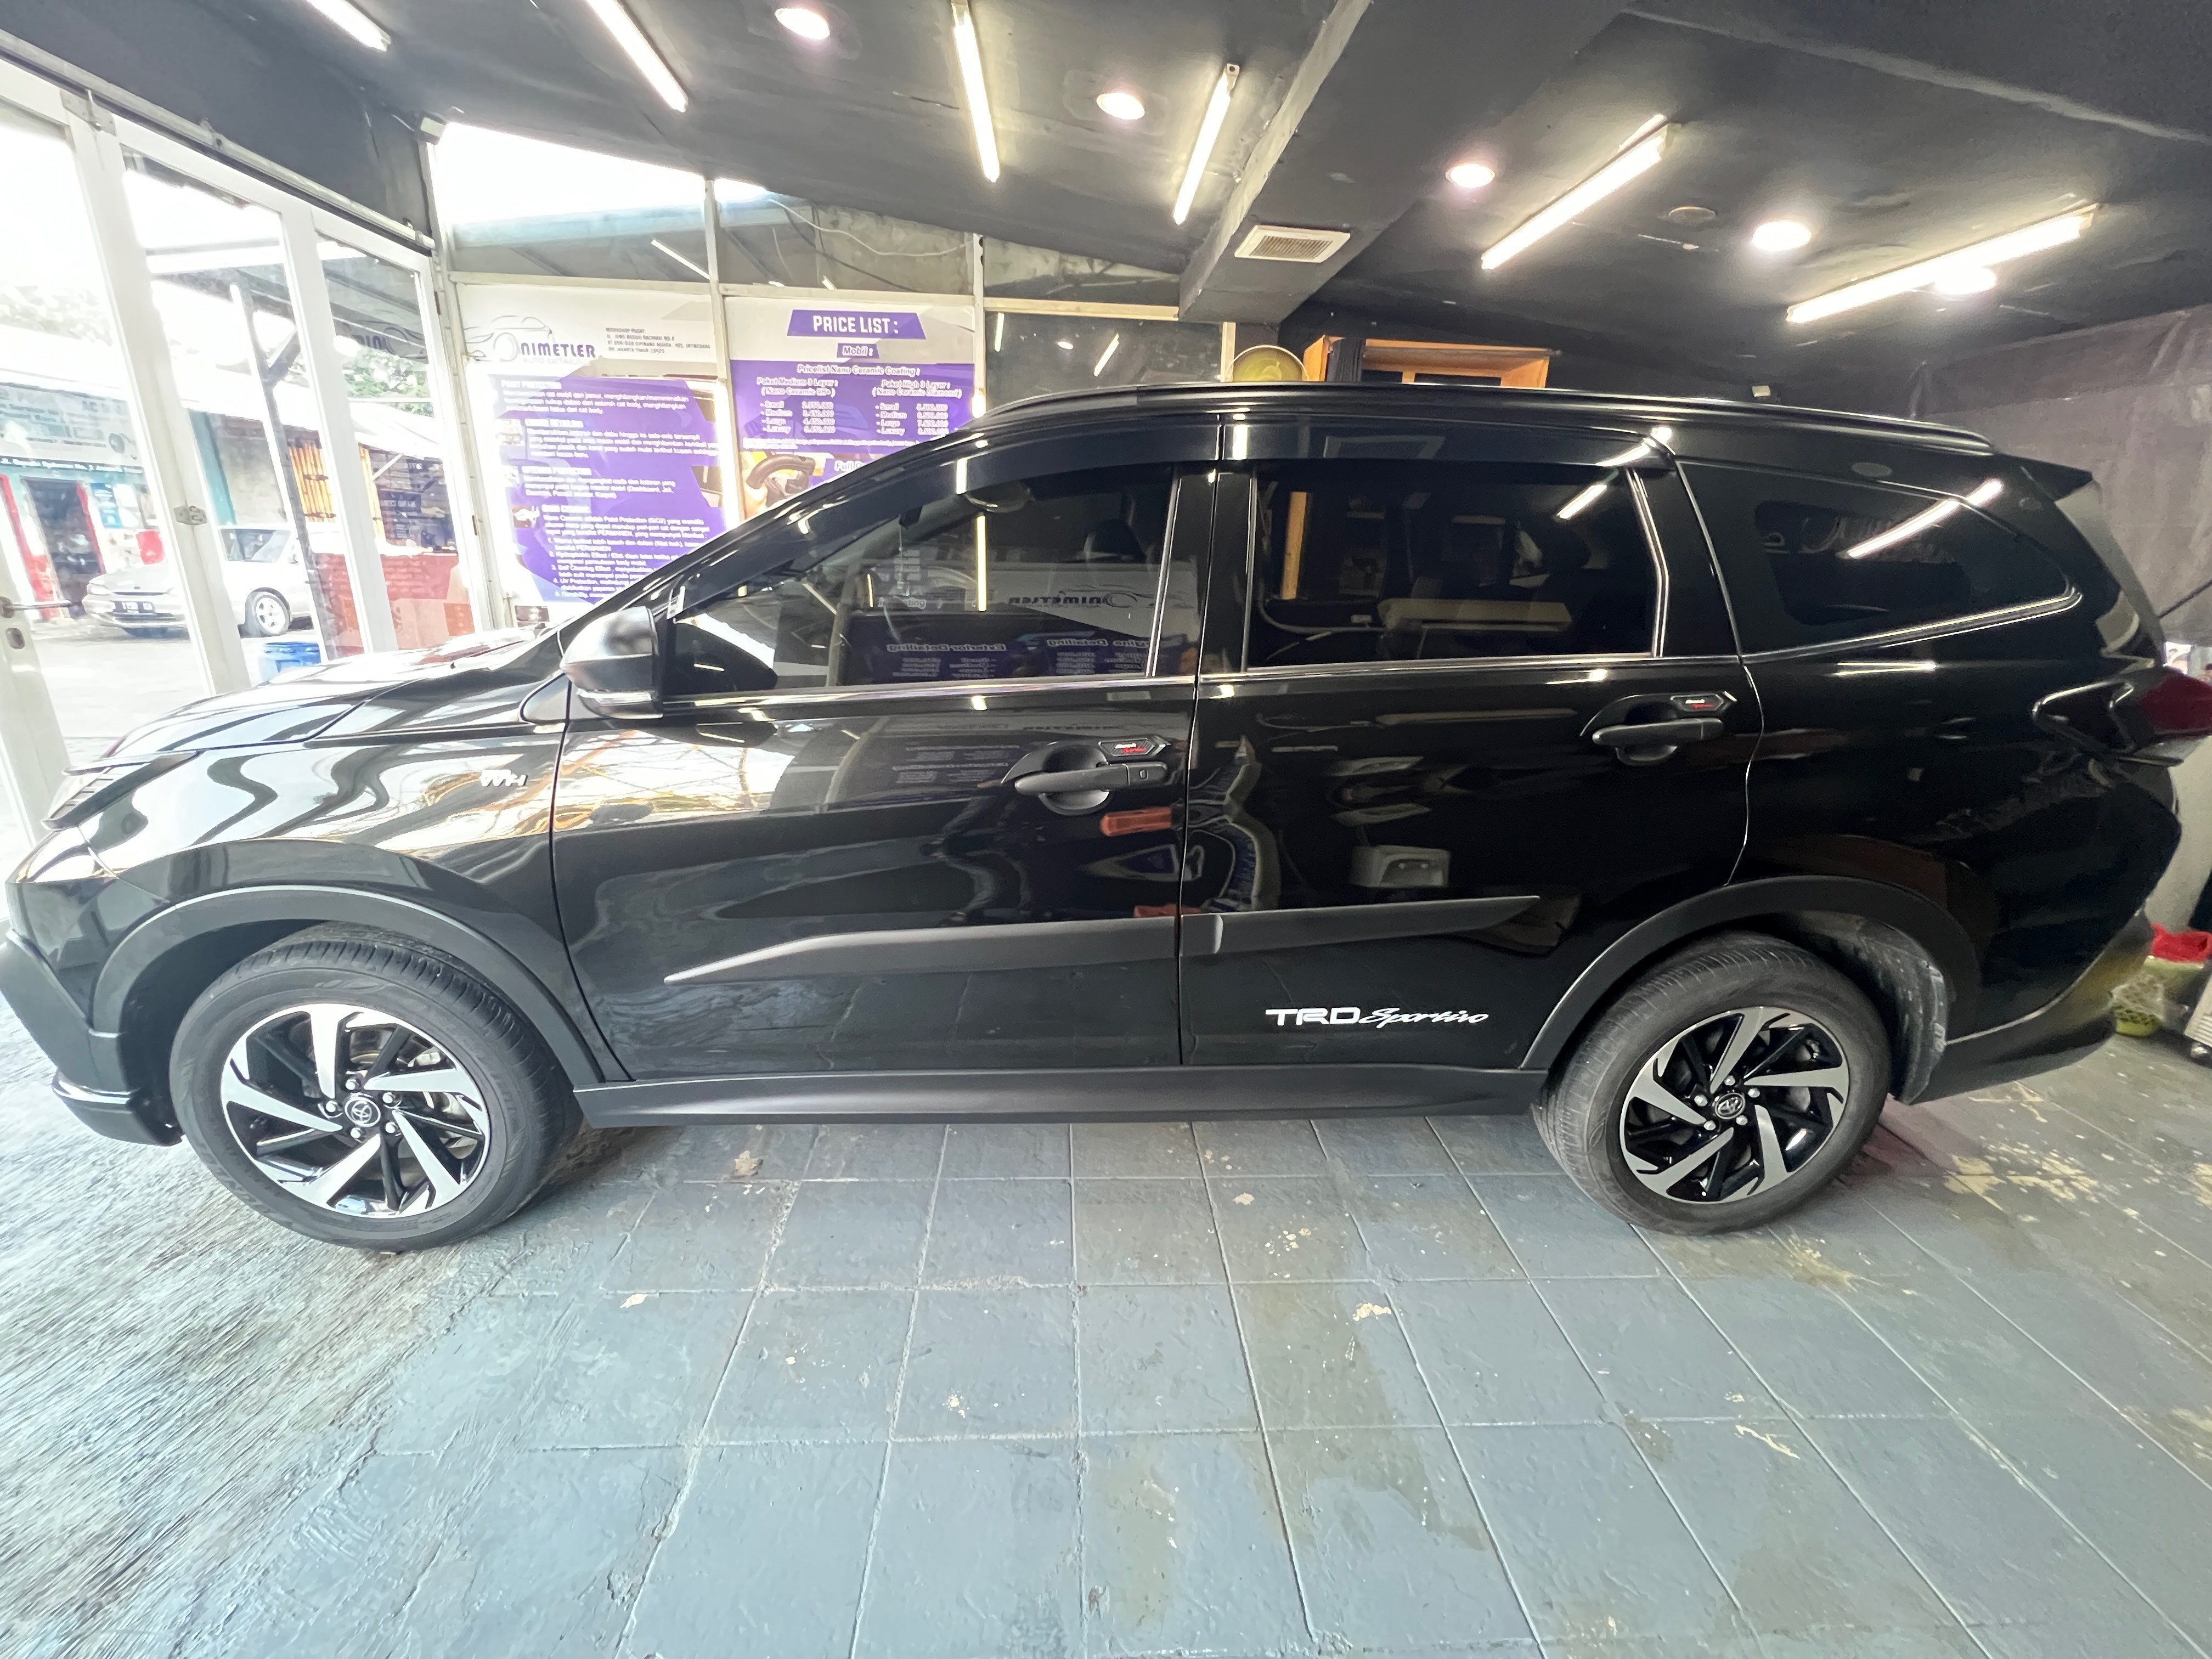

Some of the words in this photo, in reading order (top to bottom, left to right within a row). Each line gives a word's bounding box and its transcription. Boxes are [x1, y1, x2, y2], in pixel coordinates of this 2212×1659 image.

[813, 315, 856, 332] PRICE
[860, 317, 890, 334] LIST
[842, 346, 868, 356] Mobil
[797, 364, 830, 374] Pricelist
[830, 366, 851, 374] Nano
[852, 365, 884, 375] Ceramic
[885, 366, 916, 377] Coating
[757, 377, 778, 386] Paket
[778, 377, 806, 386] Medium
[813, 379, 834, 388] Layer
[881, 380, 902, 388] Paket
[902, 380, 919, 390] High
[926, 381, 947, 390] Layer
[786, 387, 816, 396] Ceramic
[896, 388, 926, 396] Ceramic
[1265, 1007, 1361, 1026] TRD
[1359, 1007, 1489, 1029] Sportivo
